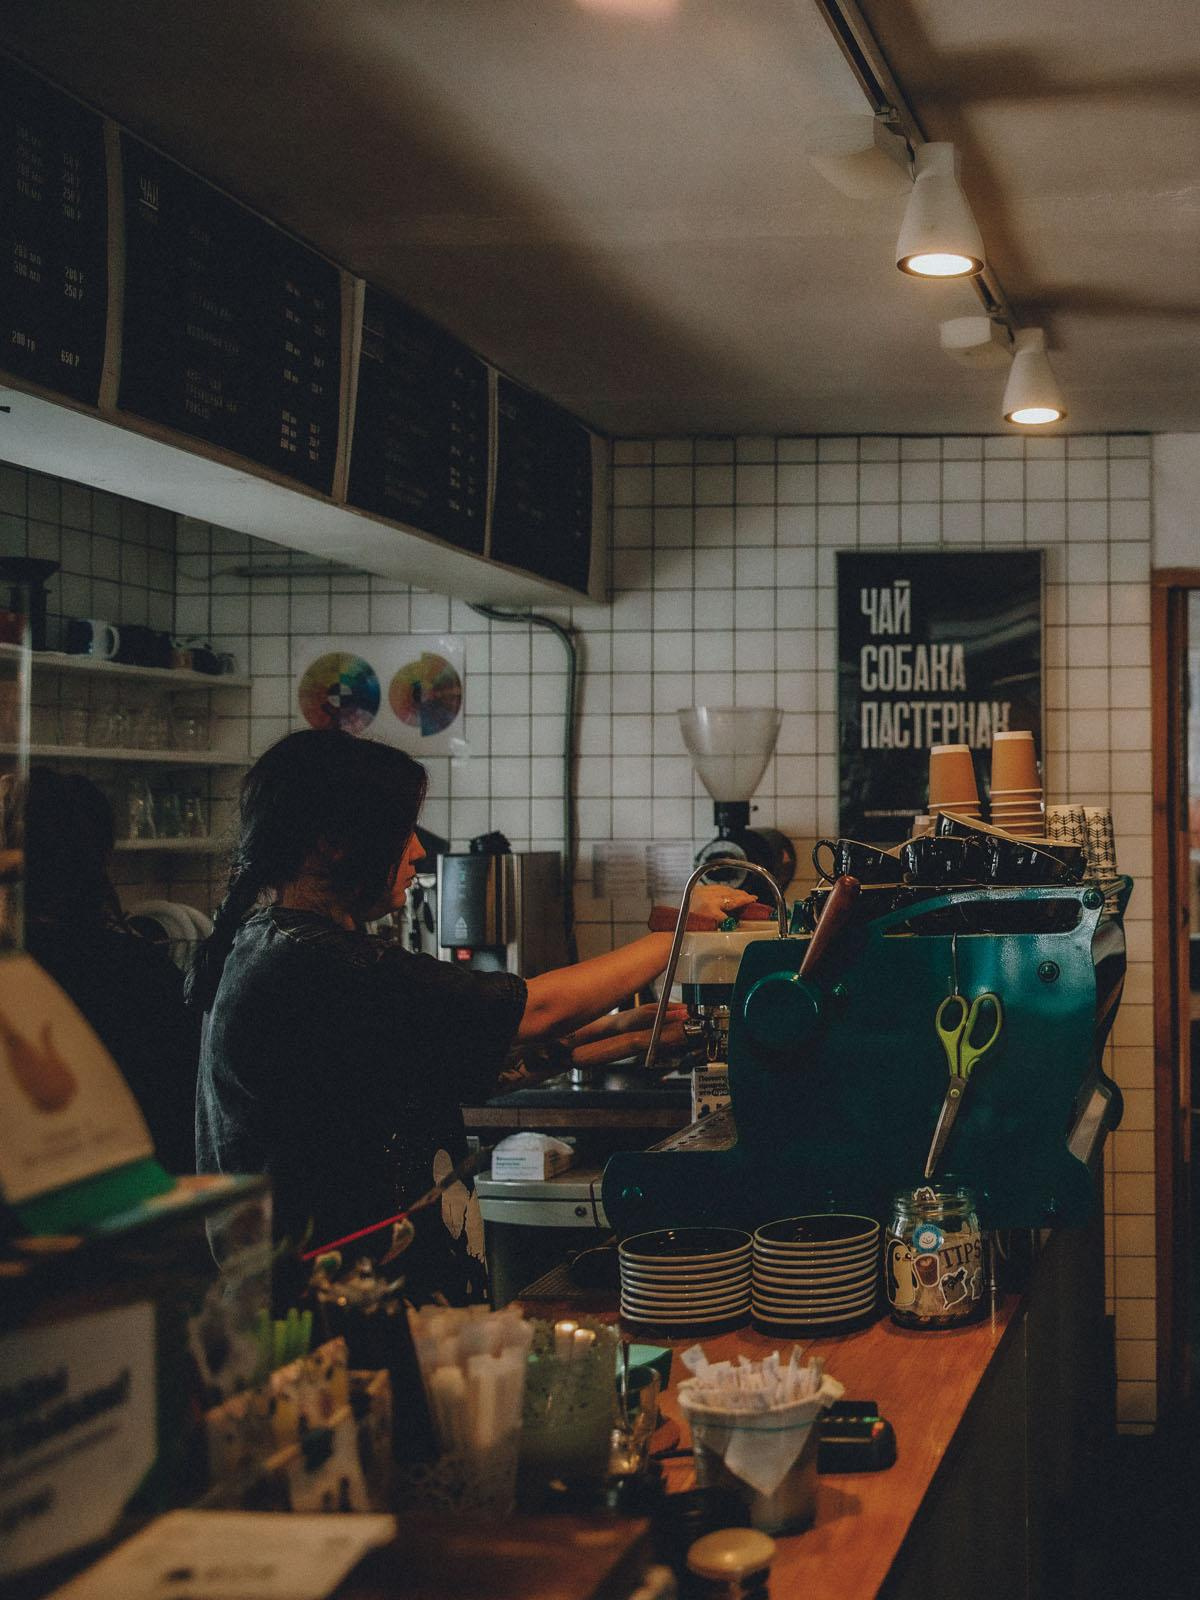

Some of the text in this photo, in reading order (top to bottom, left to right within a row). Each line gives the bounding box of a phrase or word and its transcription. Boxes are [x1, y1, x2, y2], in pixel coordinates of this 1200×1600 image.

[860, 579, 912, 635] ЧАЙ
[860, 643, 968, 692] СОБАКА
[938, 1239, 981, 1268] TIPS
